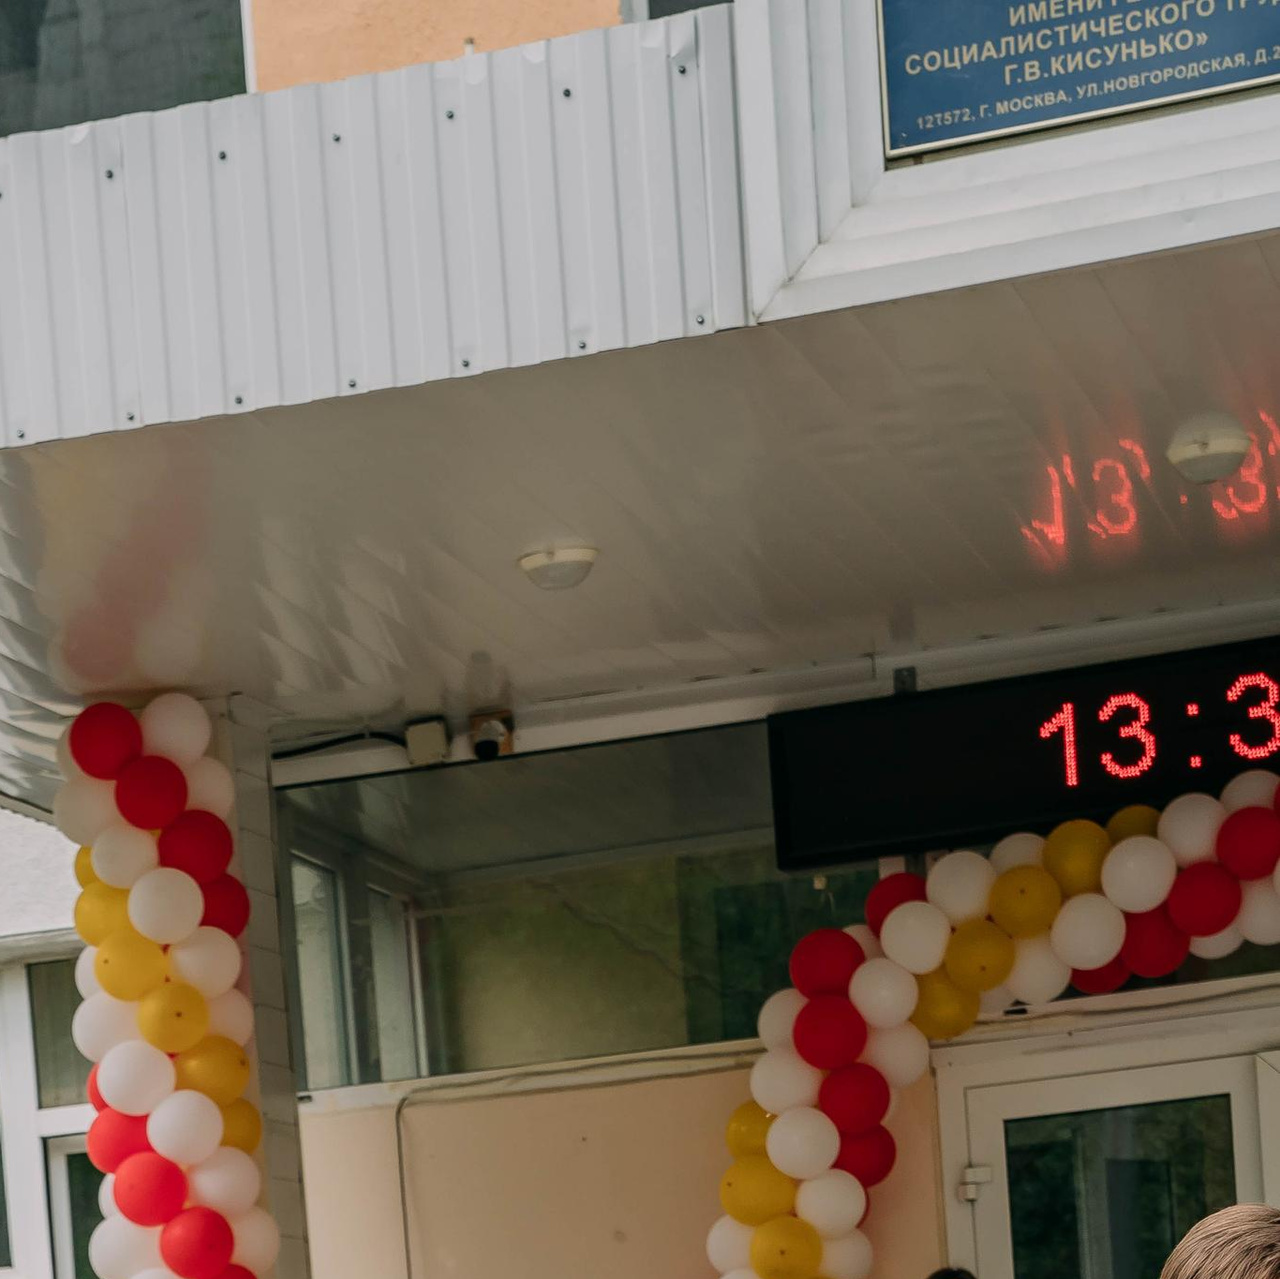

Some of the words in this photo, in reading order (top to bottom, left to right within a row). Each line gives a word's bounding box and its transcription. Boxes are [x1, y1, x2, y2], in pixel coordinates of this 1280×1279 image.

[904, 0, 1216, 75] СОЦИАЛИСТИЧЕСКОГО
[1004, 29, 1209, 86] Г.В.КИСУНЬКО»
[995, 89, 1073, 115] МОСКВА,
